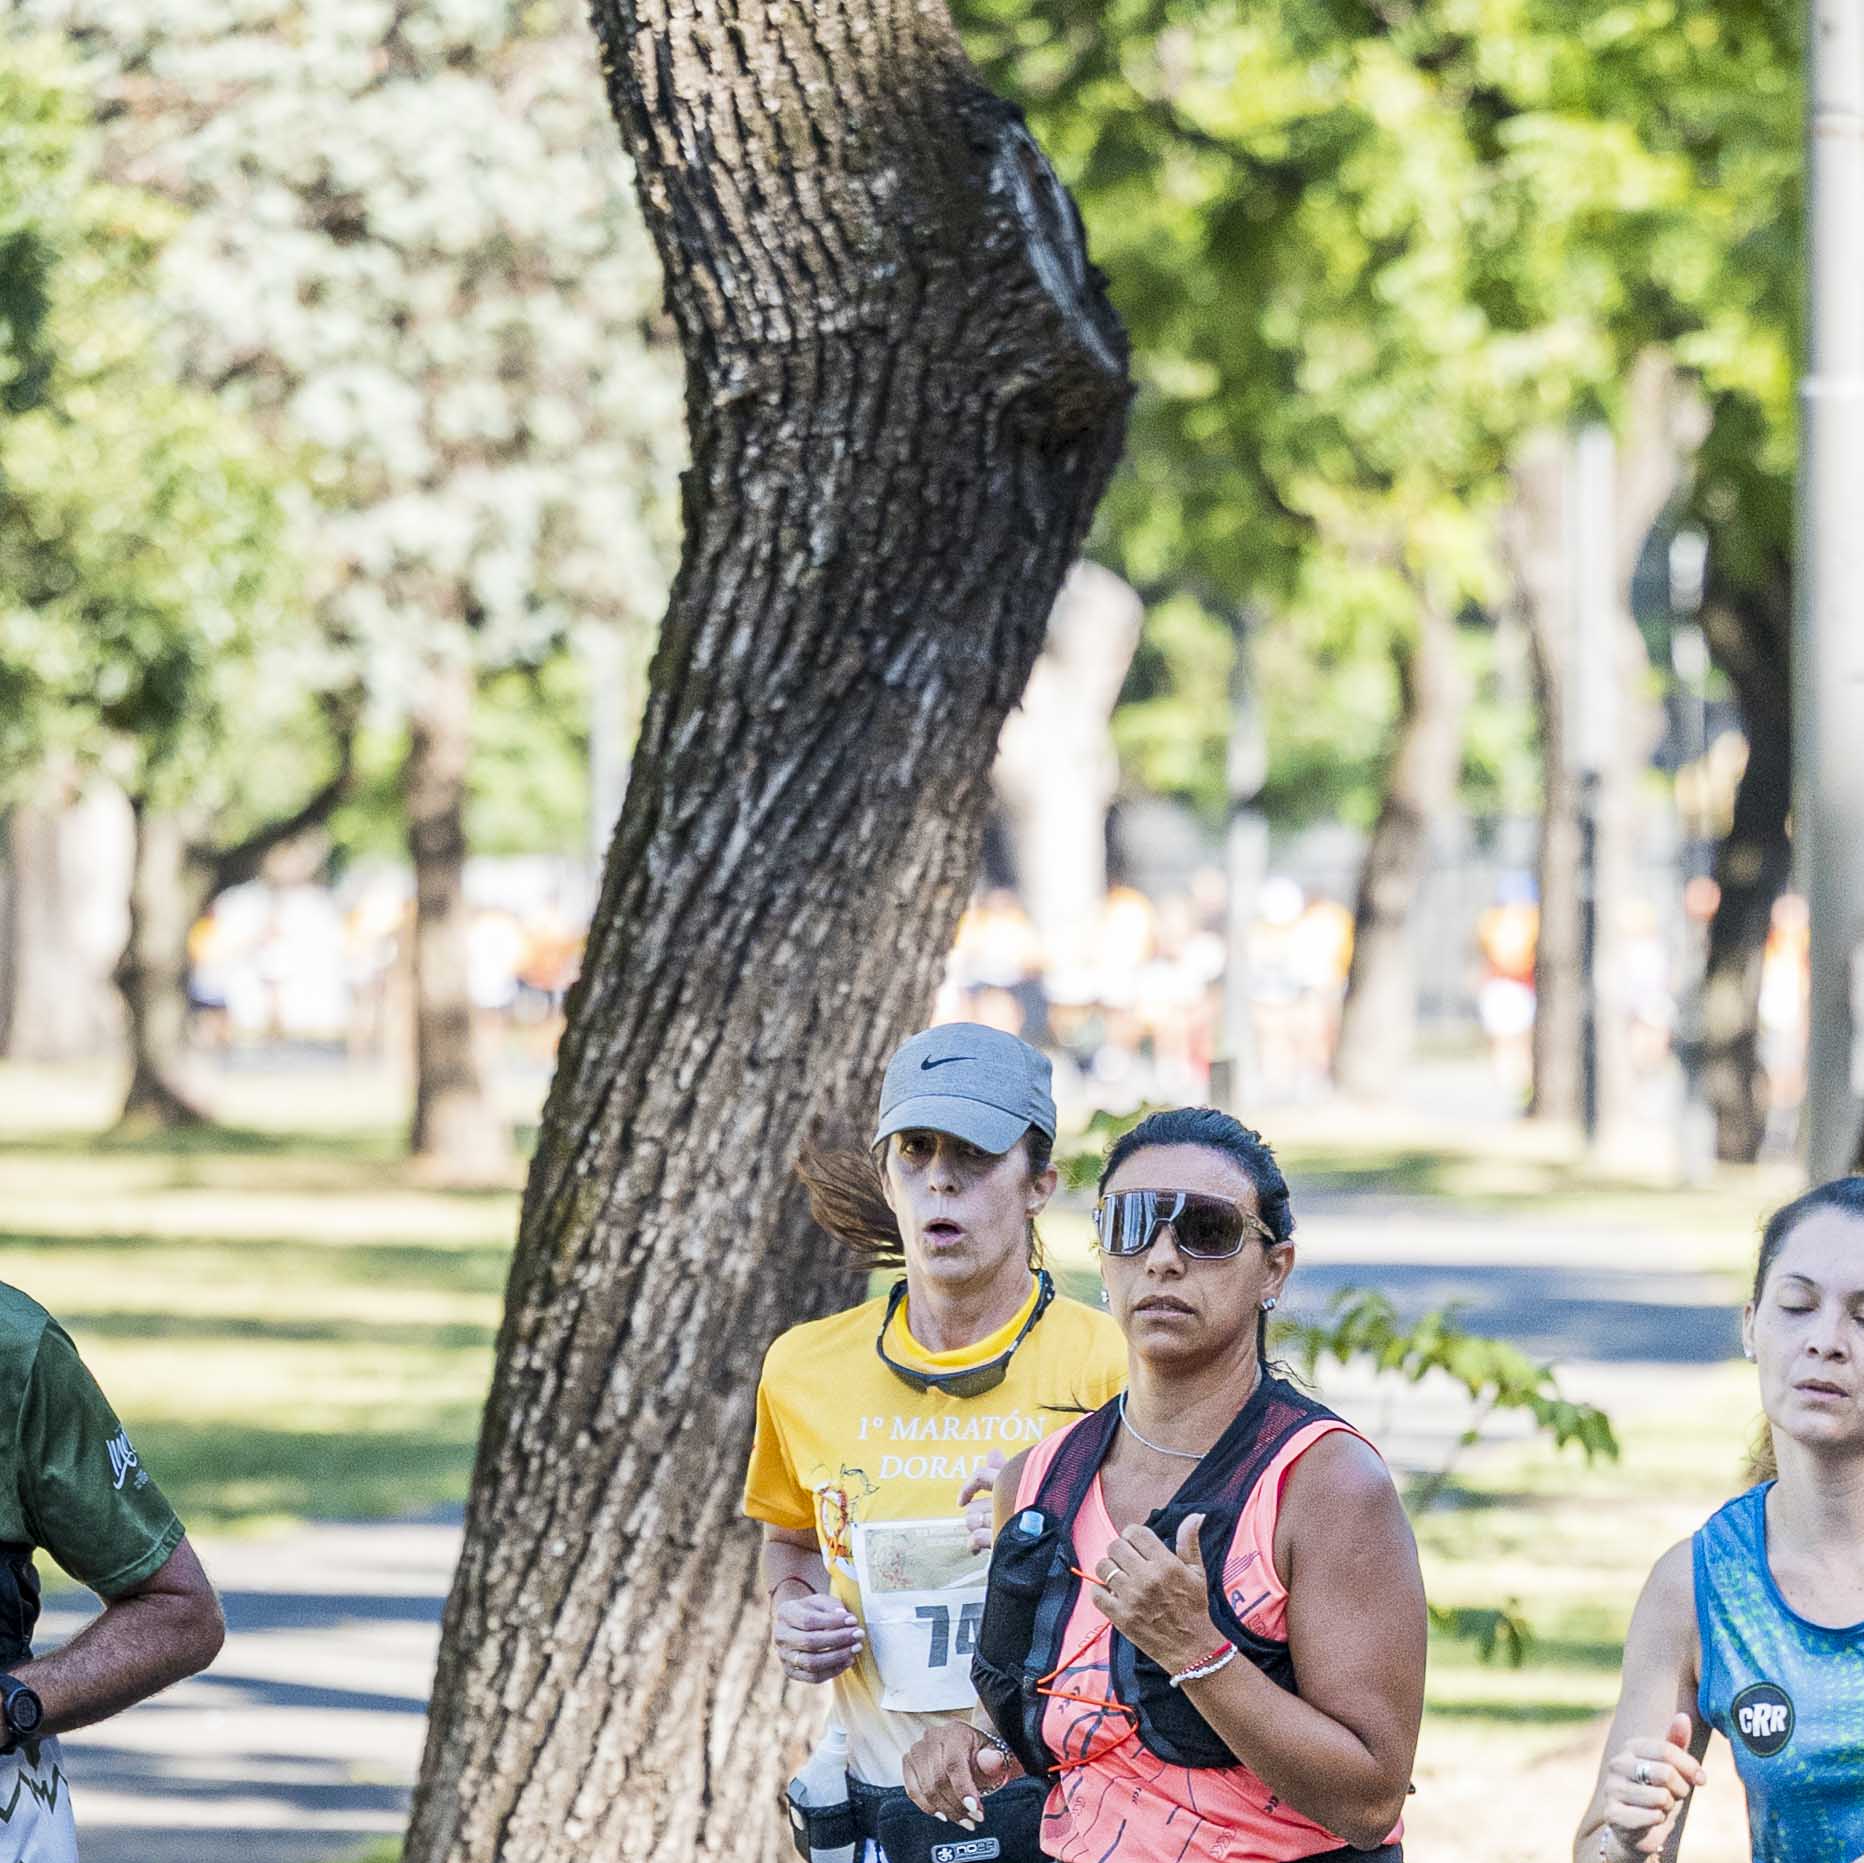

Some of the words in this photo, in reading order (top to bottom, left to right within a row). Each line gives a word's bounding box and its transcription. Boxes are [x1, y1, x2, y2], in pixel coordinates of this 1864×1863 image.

[889, 1408, 1047, 1441] MARATÓN
[879, 1454, 988, 1480] DORA
[1739, 1702, 1788, 1737] CRR
